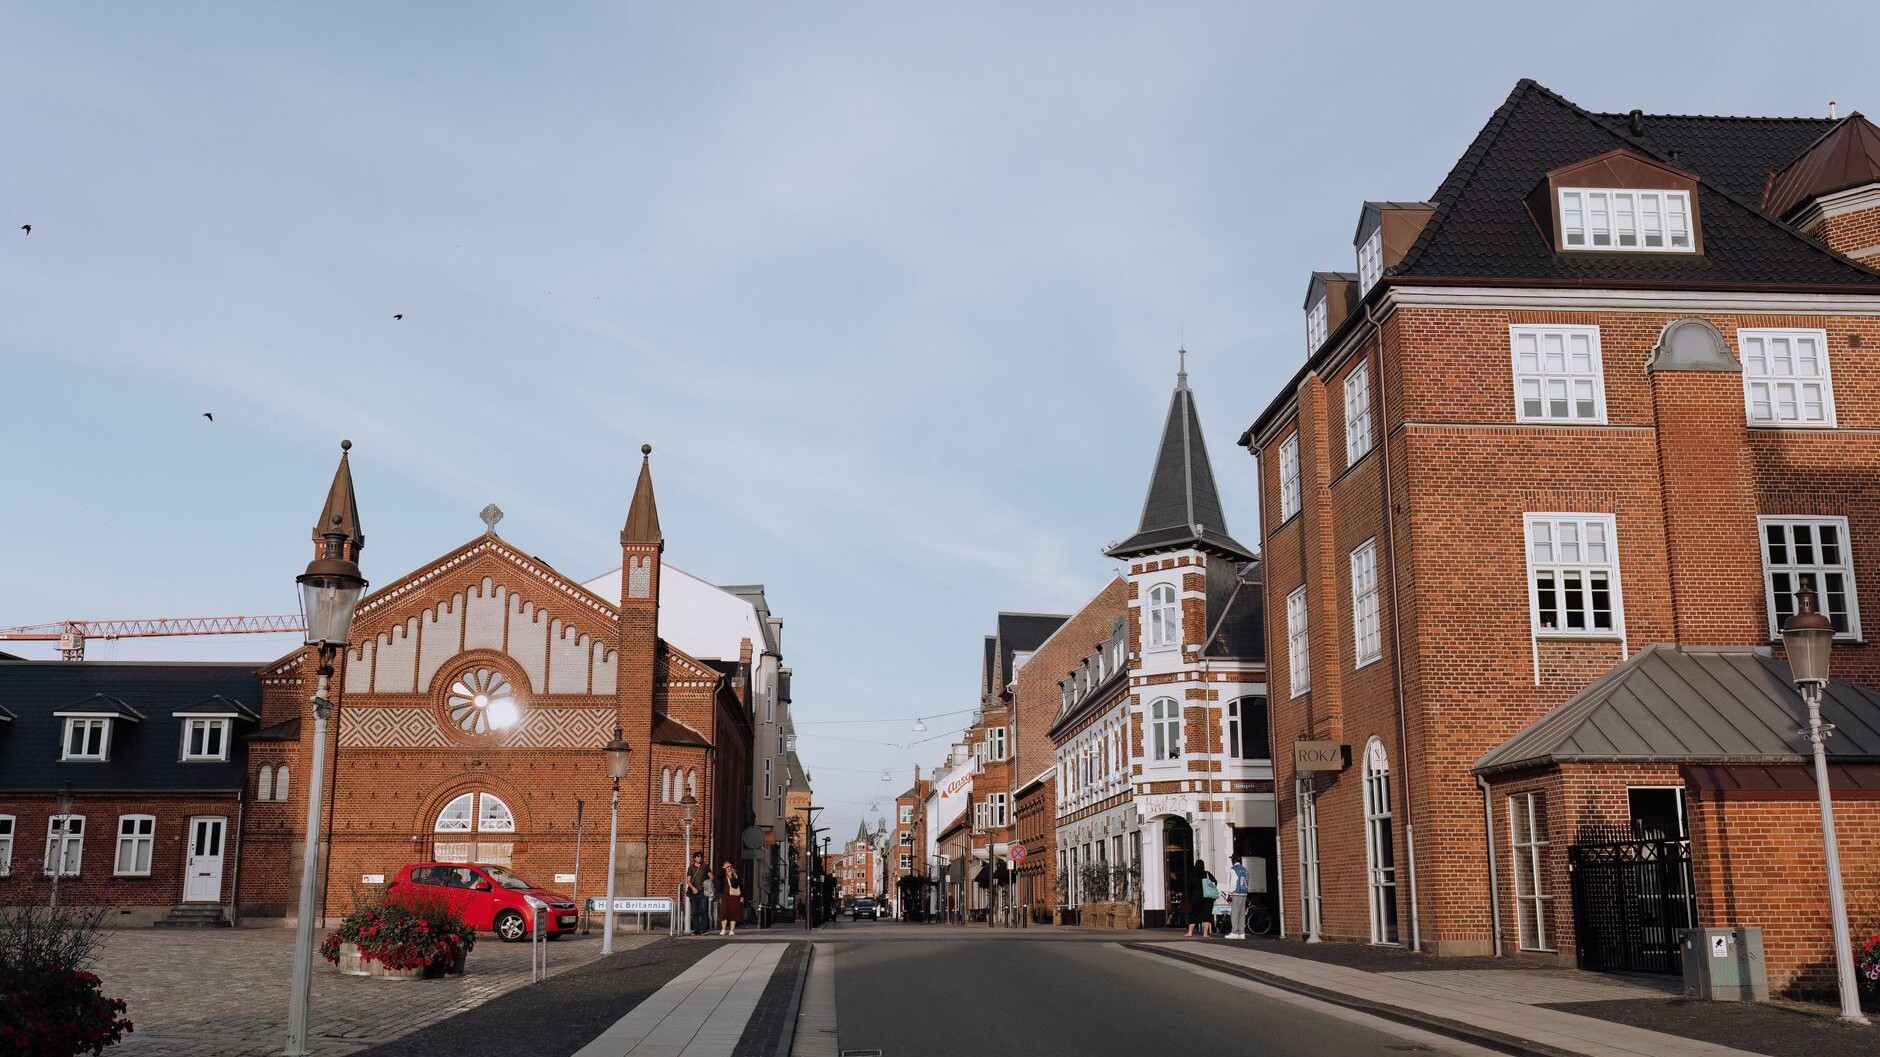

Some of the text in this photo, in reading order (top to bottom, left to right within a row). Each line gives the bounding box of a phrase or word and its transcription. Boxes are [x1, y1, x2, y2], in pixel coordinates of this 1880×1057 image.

[1299, 749, 1337, 762] ROKZ
[598, 901, 666, 909] Hel Britannia
